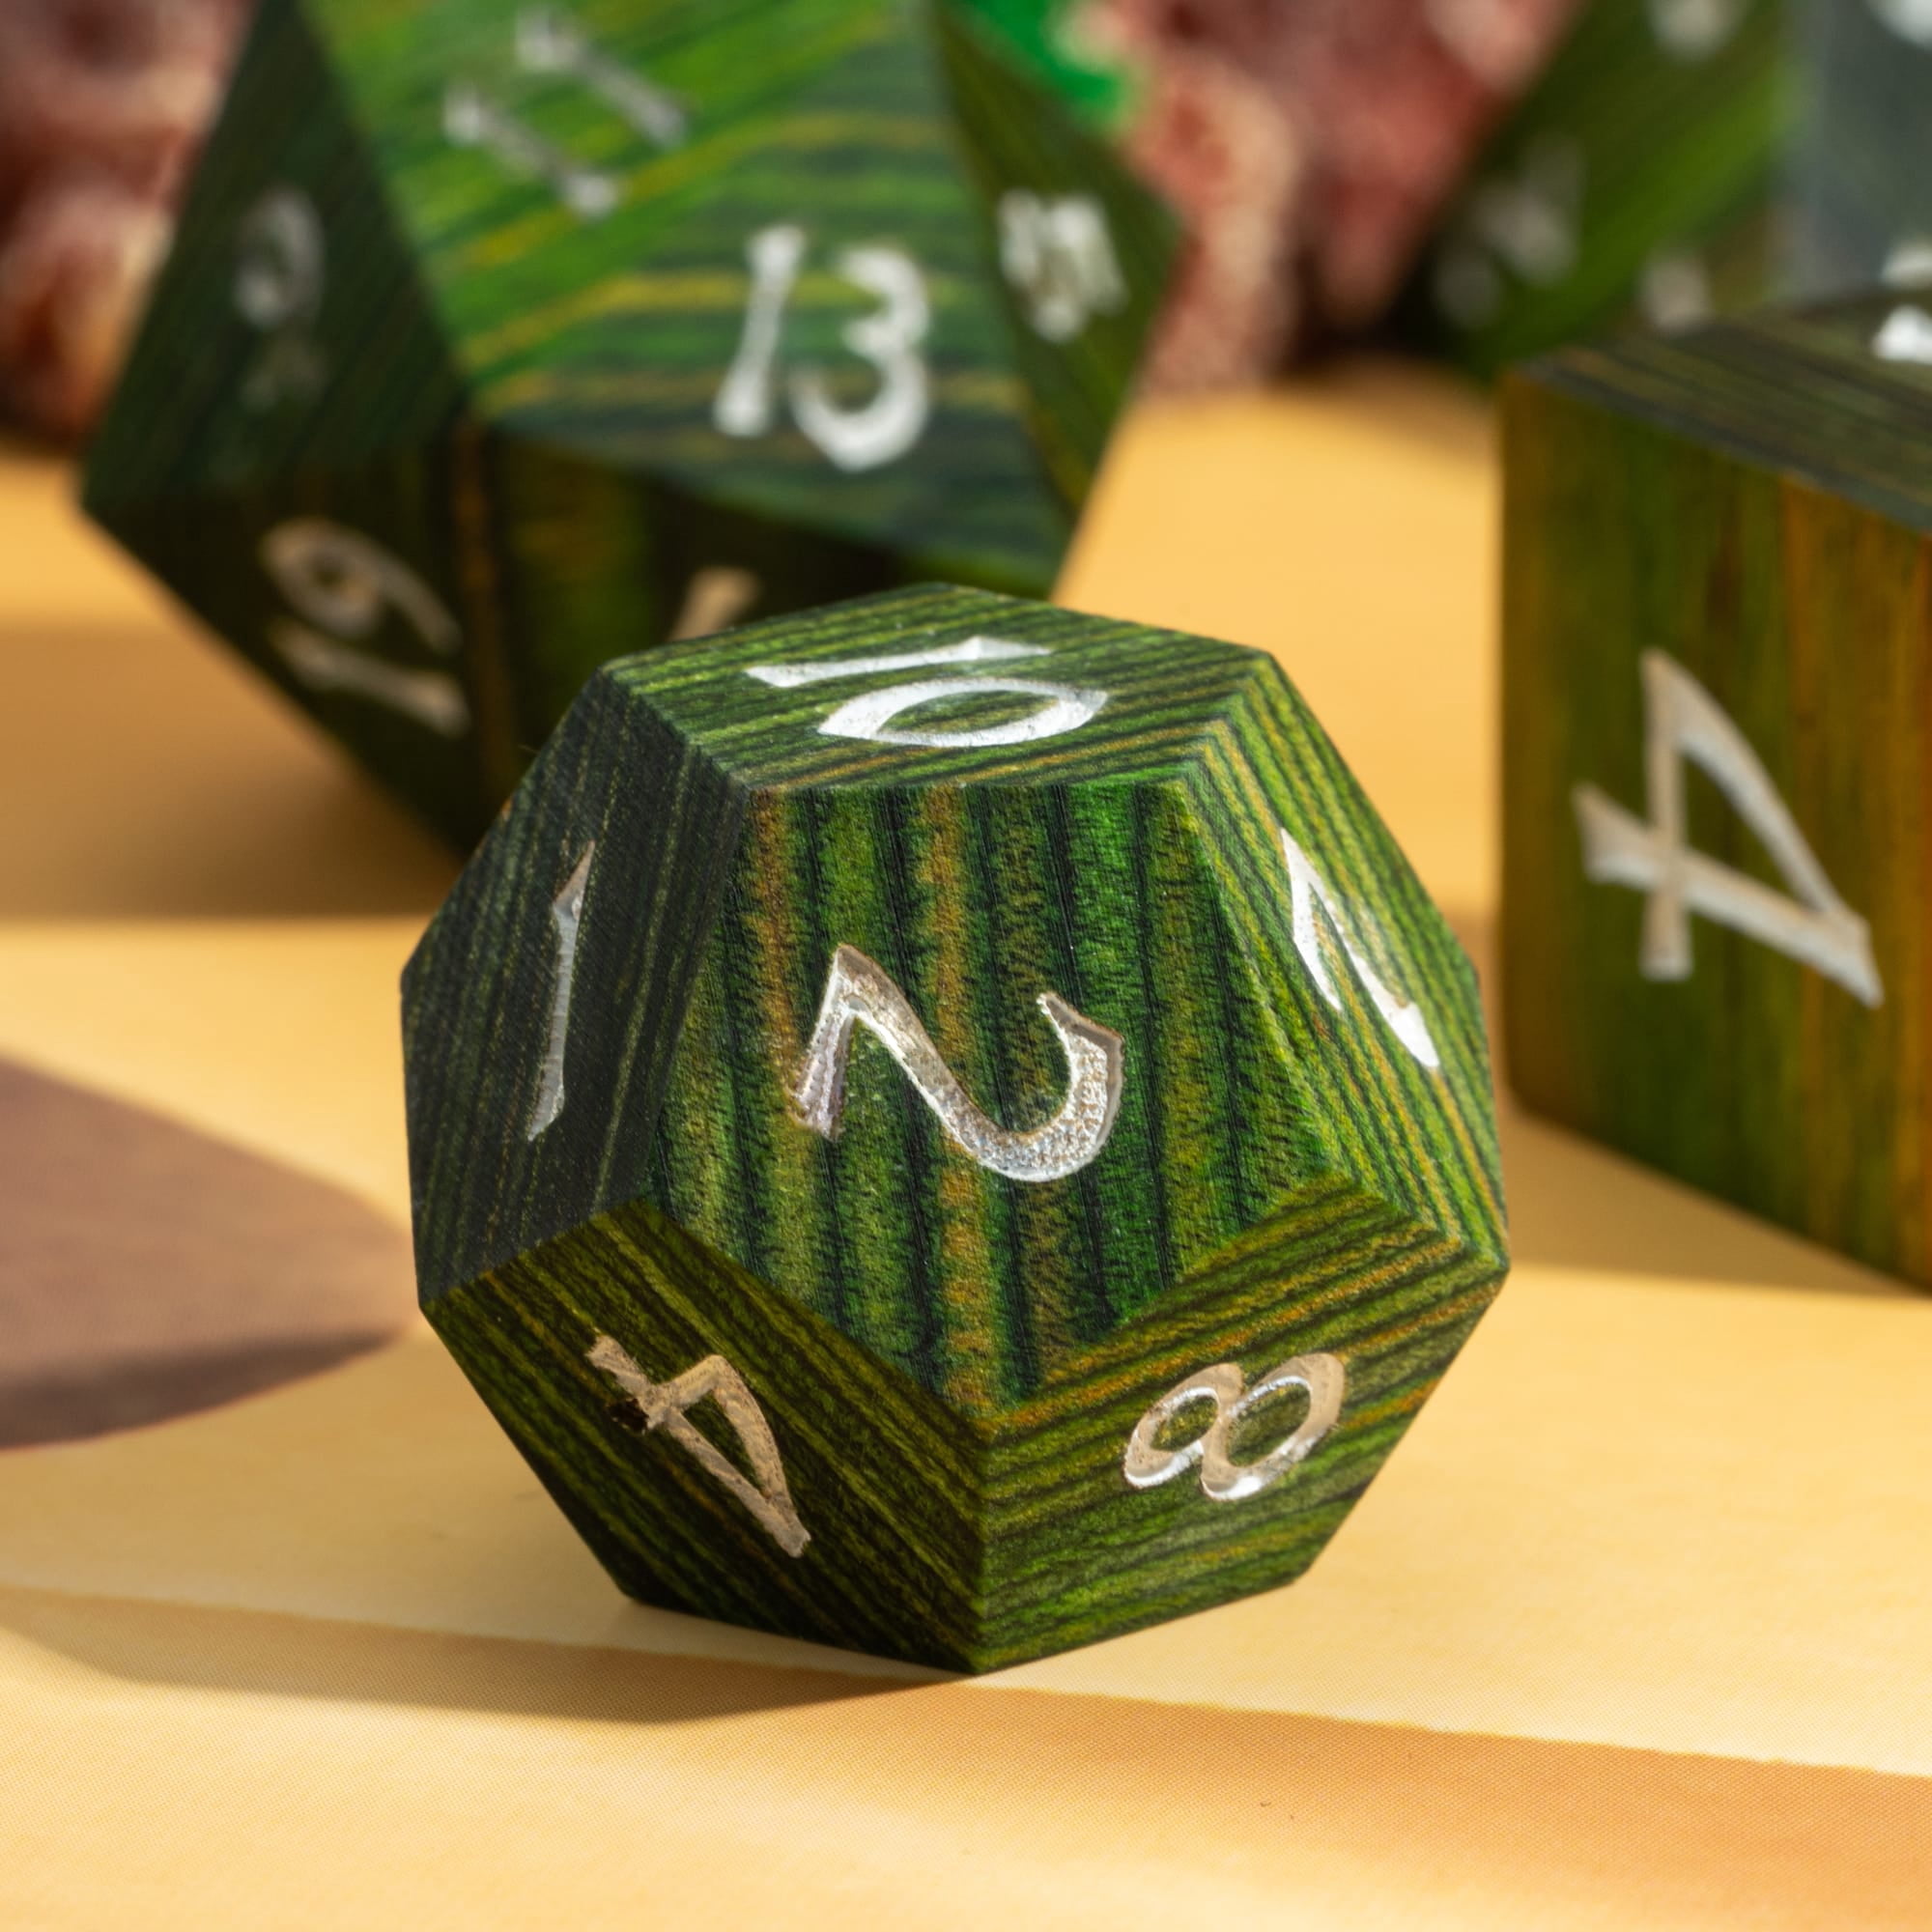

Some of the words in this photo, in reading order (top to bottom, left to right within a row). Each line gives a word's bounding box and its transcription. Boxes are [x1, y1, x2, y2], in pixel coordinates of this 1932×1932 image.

[713, 224, 930, 471] 13
[257, 515, 471, 740] 19
[744, 635, 1109, 748] 10
[1573, 645, 1884, 1010] 4
[527, 840, 595, 1142] 1
[788, 943, 1125, 1182] 2
[585, 1332, 811, 1558] 4
[1122, 1352, 1347, 1502] 8
